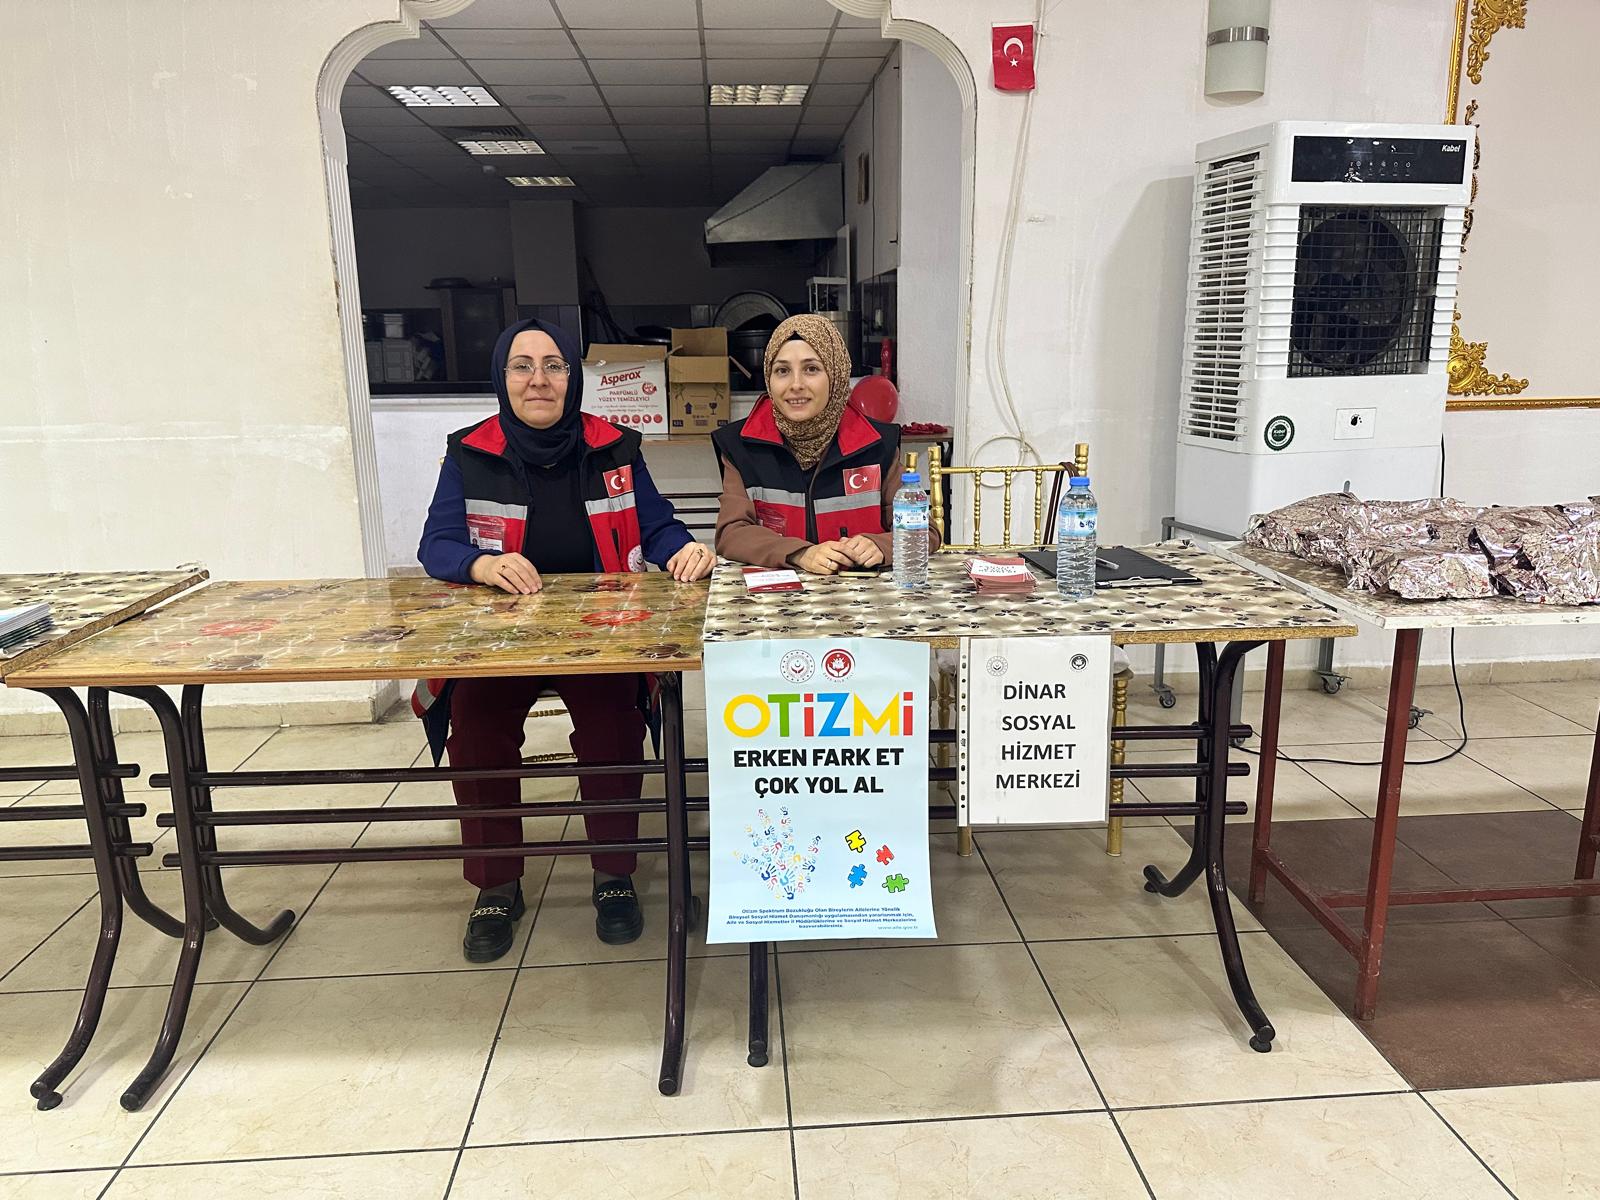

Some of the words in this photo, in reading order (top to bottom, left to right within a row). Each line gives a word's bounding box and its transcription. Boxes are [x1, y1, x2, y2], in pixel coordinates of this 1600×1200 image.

[1441, 144, 1461, 153] Kabel
[600, 371, 641, 386] Asperox
[1003, 681, 1066, 700] DİNAR
[1001, 714, 1076, 731] SOSYAL
[733, 749, 807, 767] ERKEN
[812, 748, 871, 767] FARK
[876, 748, 904, 766] ET
[1001, 741, 1077, 760] HİZMET
[754, 776, 799, 798] ÇOK
[804, 776, 848, 794] YOL
[853, 776, 884, 793] AL
[996, 769, 1080, 789] MERKEZİ
